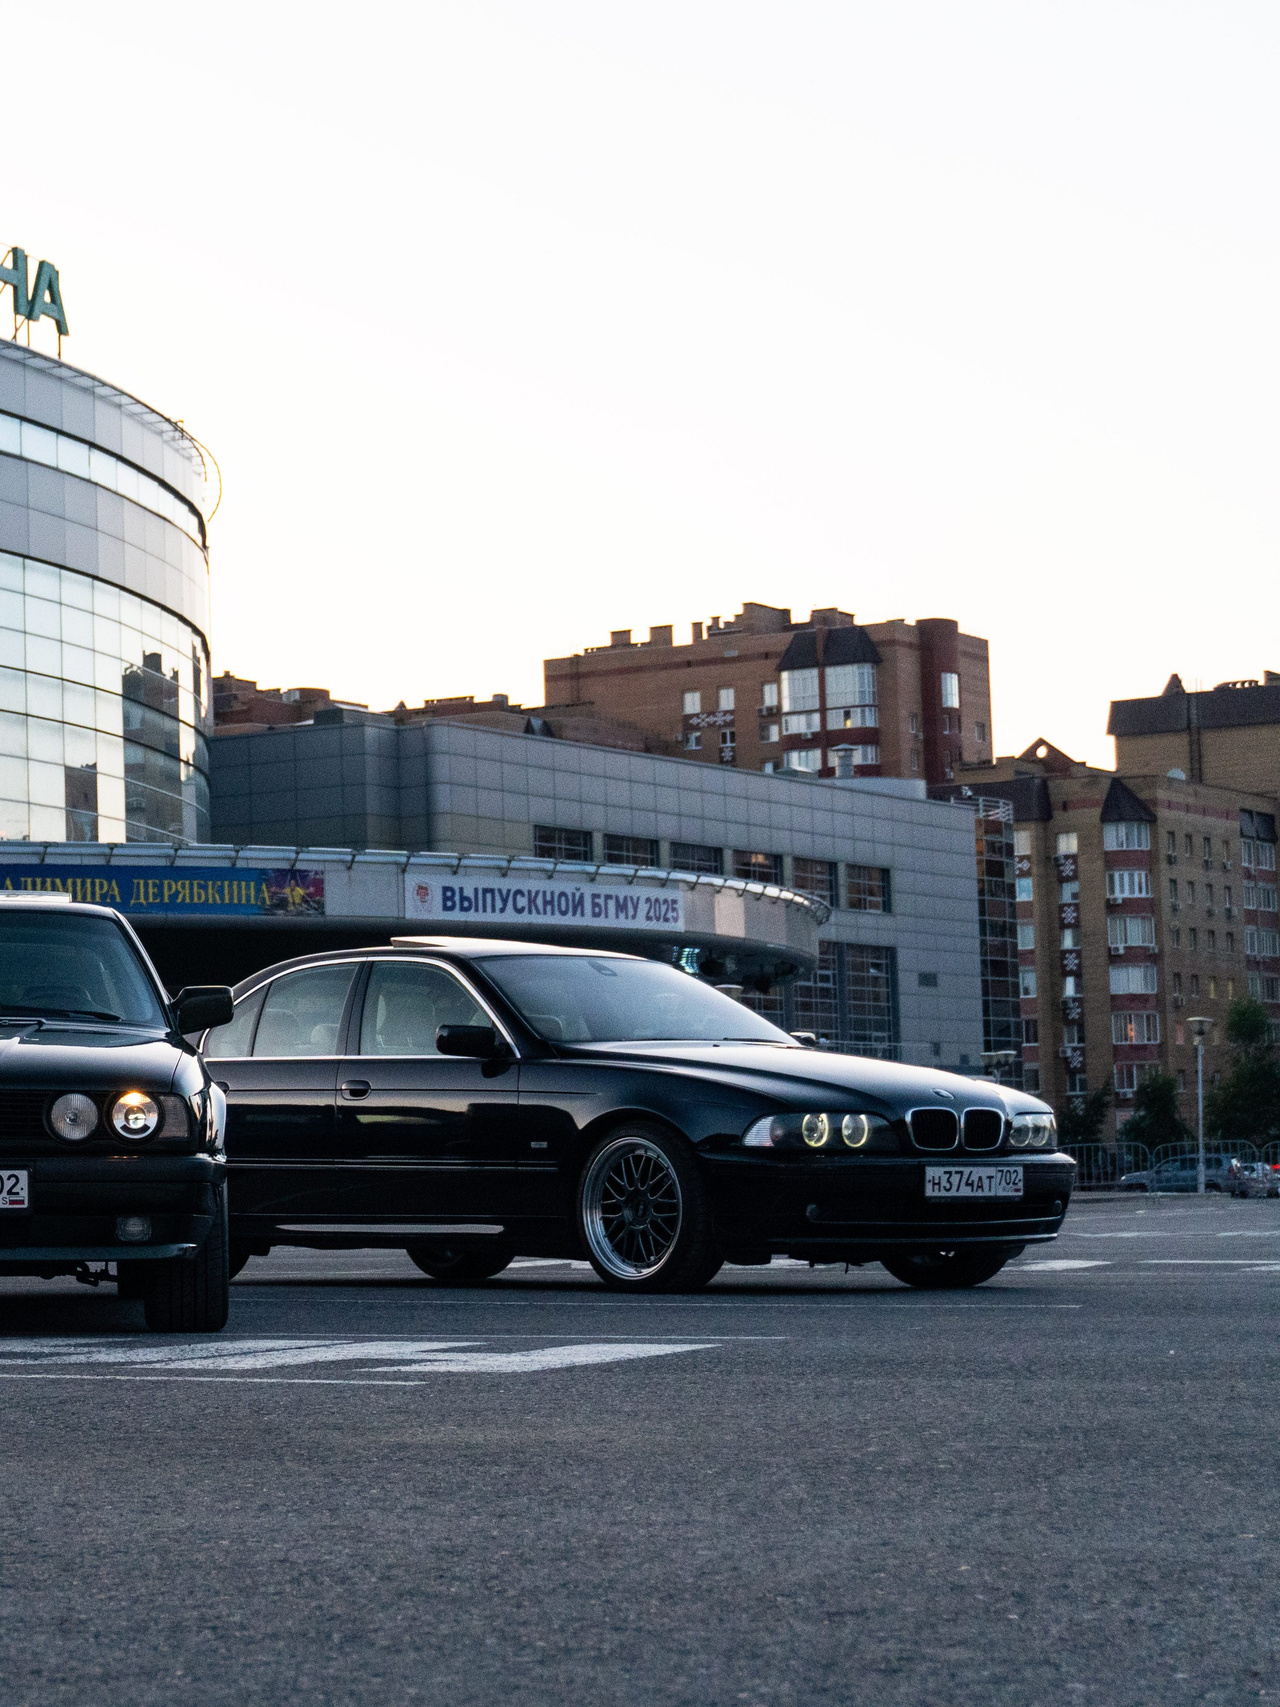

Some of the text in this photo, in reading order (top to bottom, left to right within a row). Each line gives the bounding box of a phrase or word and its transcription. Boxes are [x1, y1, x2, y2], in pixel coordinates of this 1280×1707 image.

[131, 878, 270, 908] ДЕРЯБКИНА
[442, 885, 586, 918] ВЫПУСКНОЙ
[591, 893, 641, 920] БГМУ
[645, 899, 681, 924] 2025
[932, 1169, 1019, 1192] Н374АТ 702
